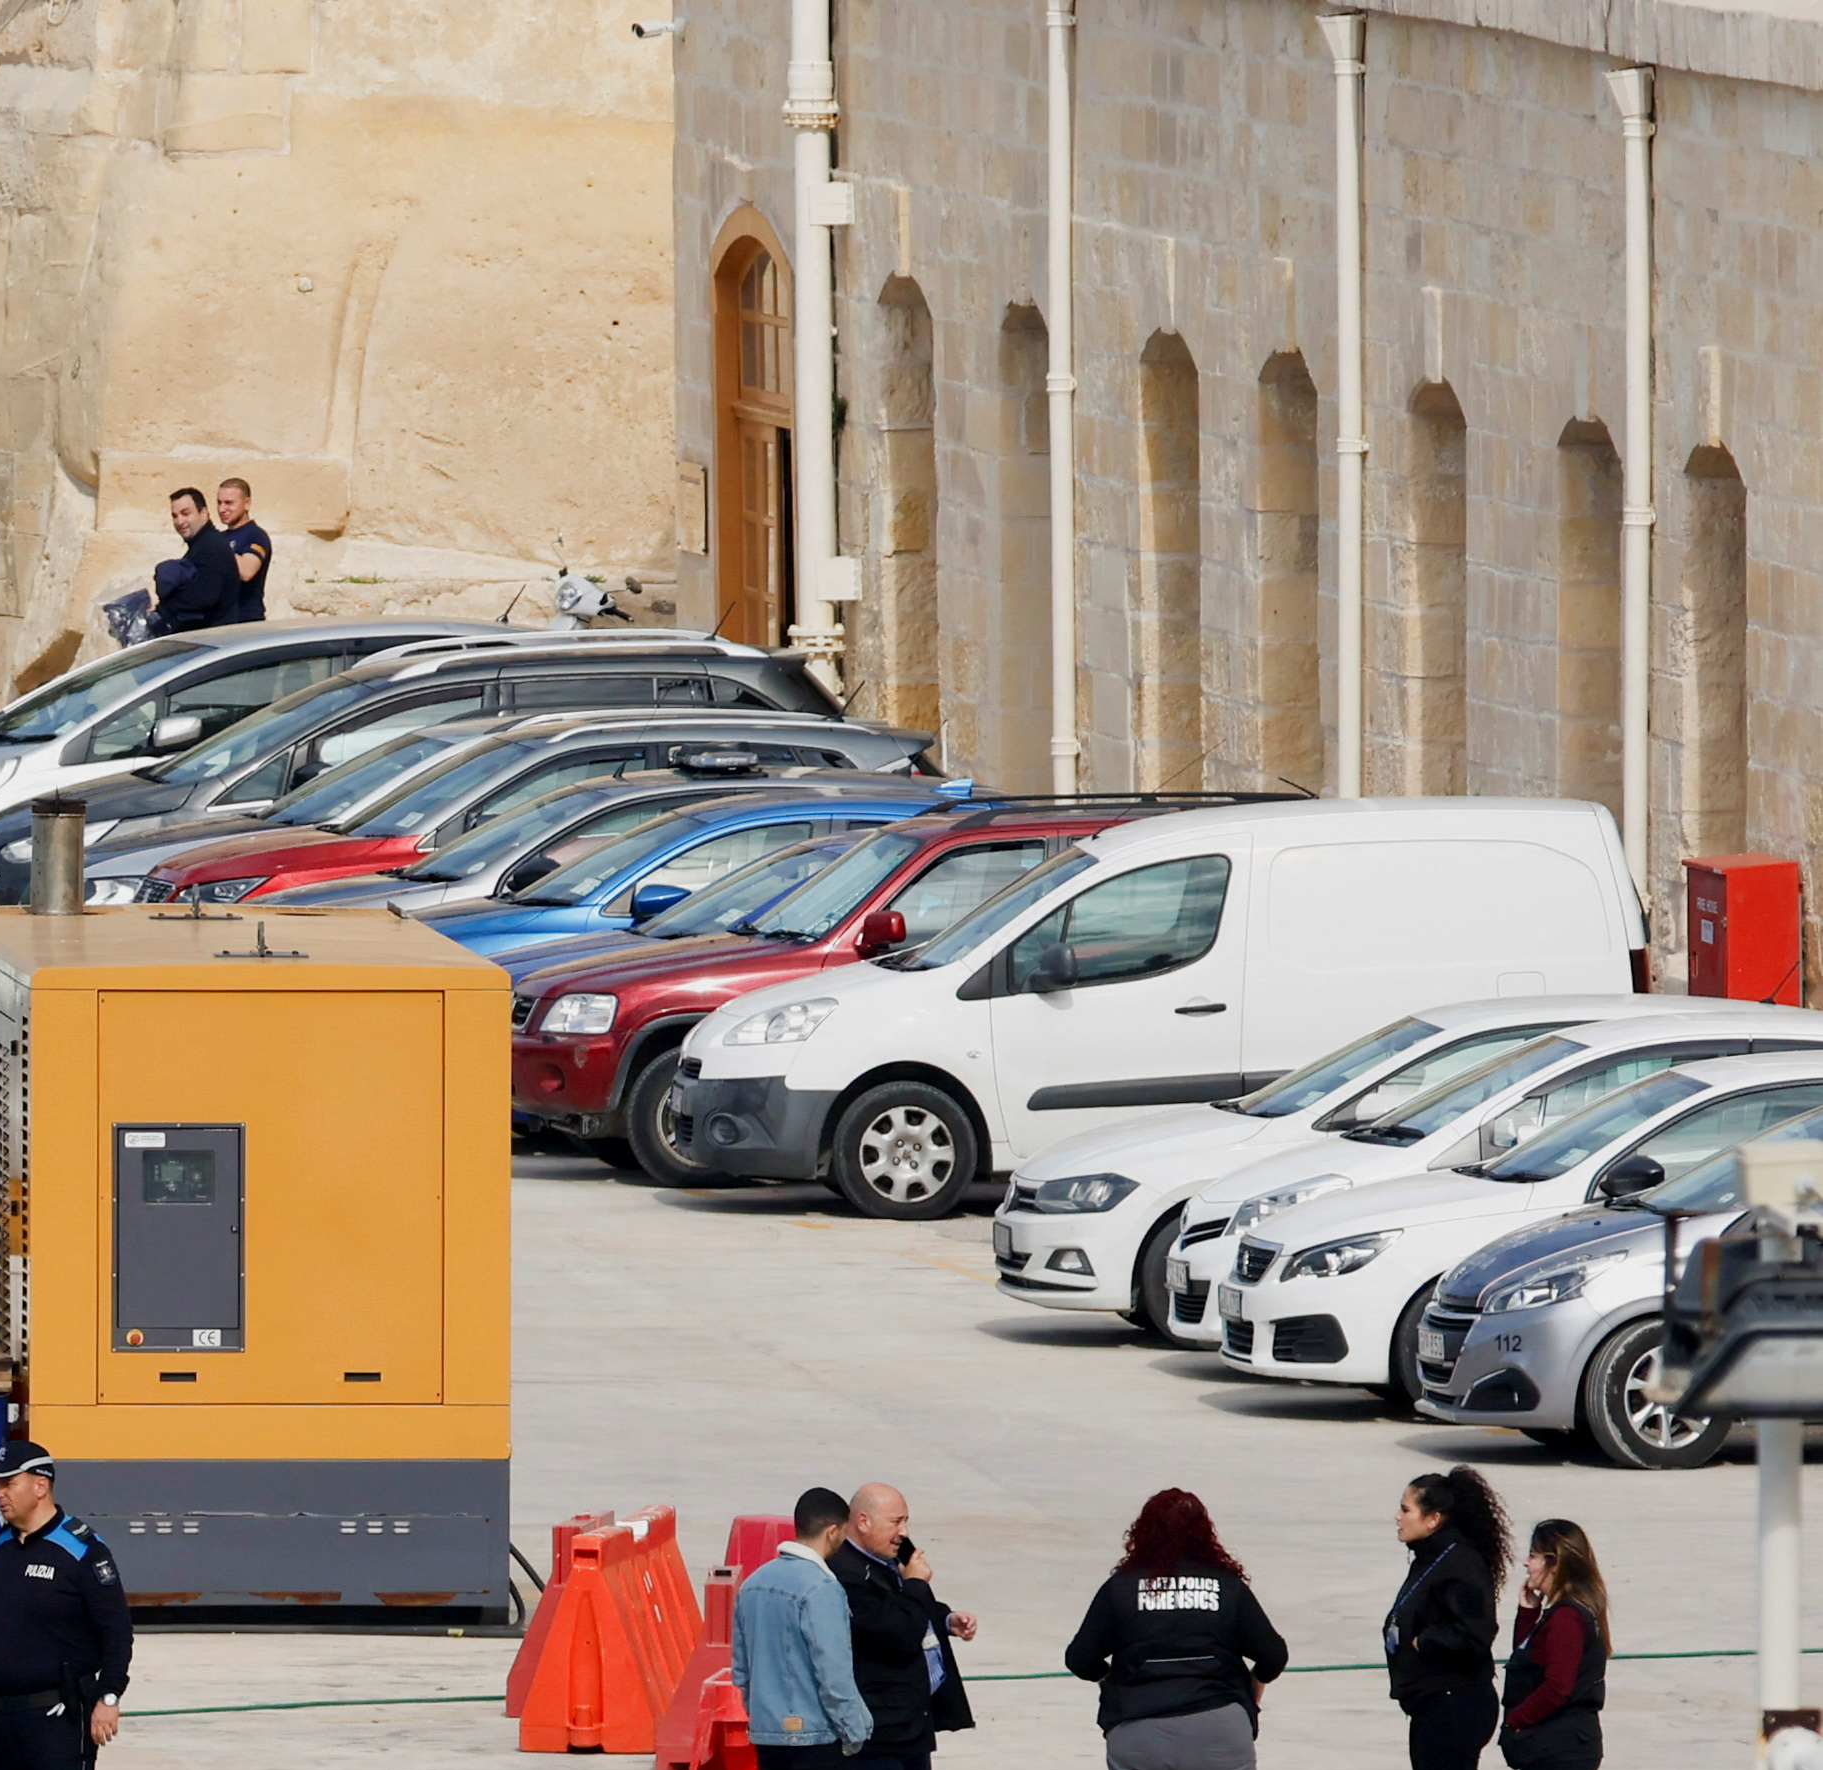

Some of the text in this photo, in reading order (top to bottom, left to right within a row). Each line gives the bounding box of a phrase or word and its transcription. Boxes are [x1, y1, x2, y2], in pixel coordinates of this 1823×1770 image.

[199, 1331, 215, 1345] CE
[1494, 1335, 1522, 1352] 112
[25, 1564, 55, 1580] PULIZIJA
[1178, 1576, 1220, 1592] POLICE
[1138, 1591, 1219, 1611] FORENSICS
